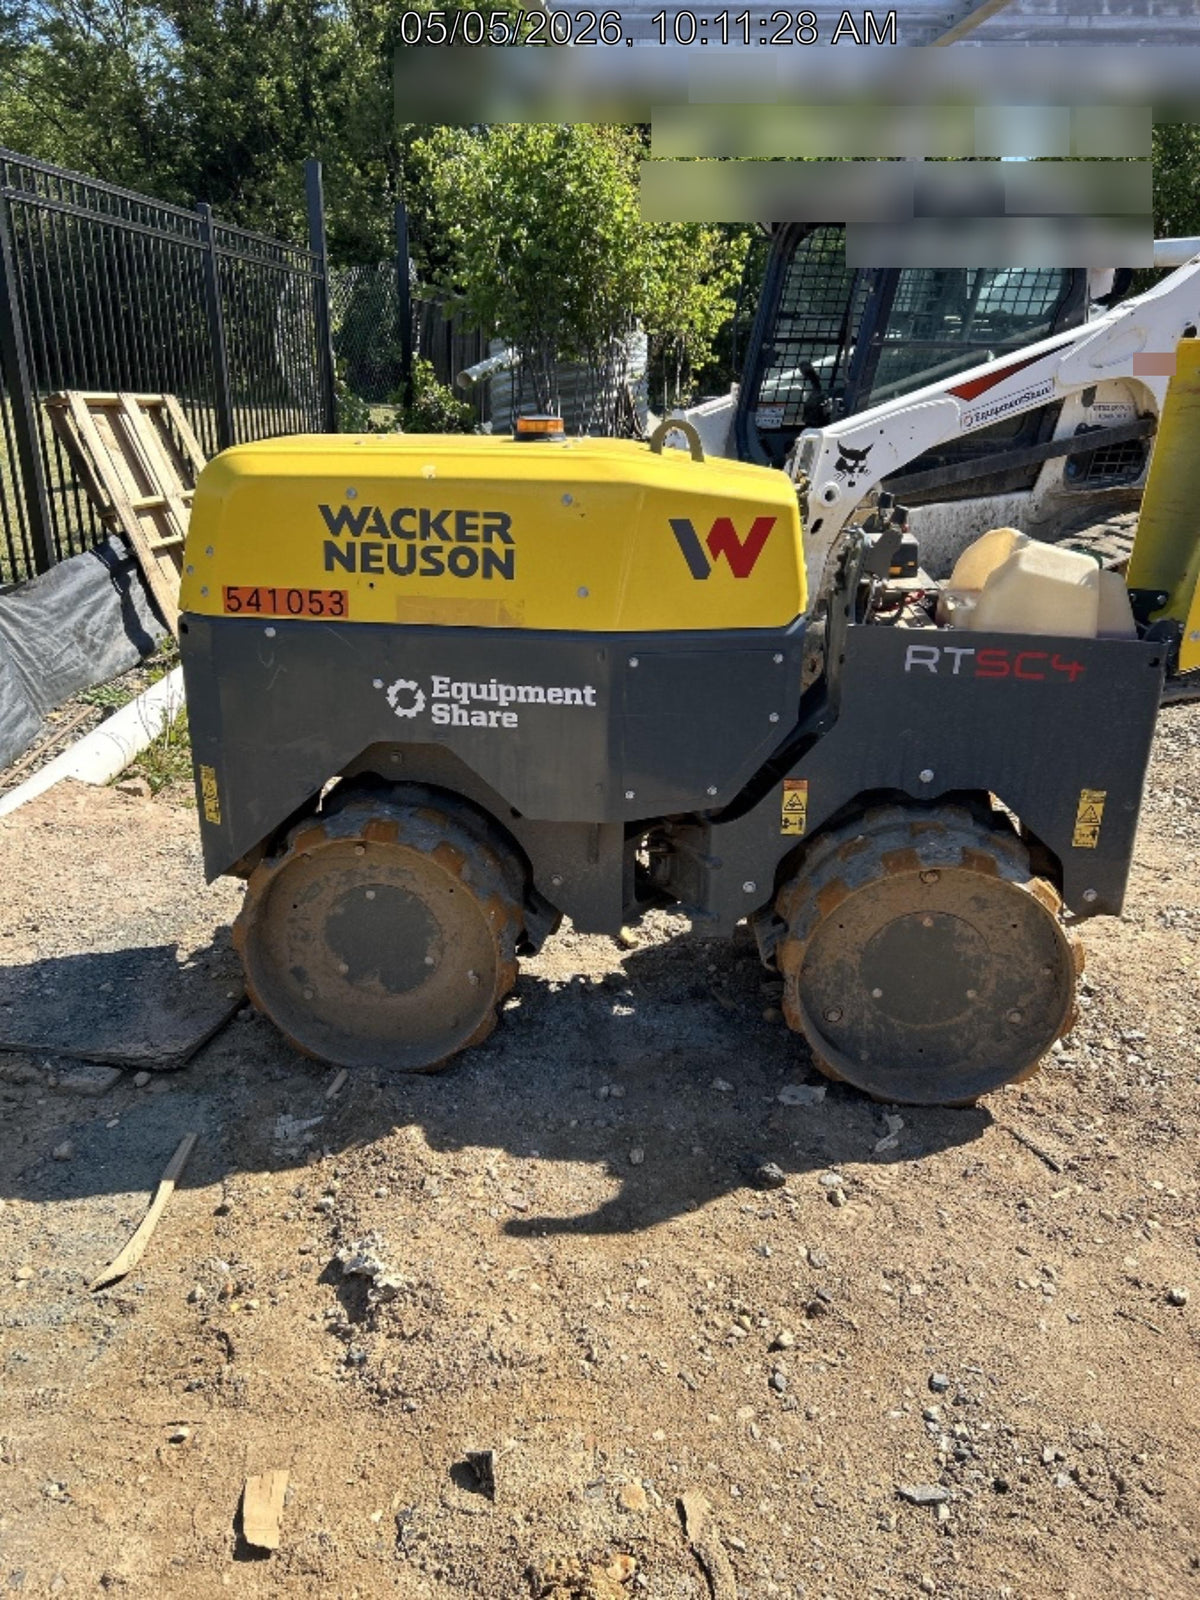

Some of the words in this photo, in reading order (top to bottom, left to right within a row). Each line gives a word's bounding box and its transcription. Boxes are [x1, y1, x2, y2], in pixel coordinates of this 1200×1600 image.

[318, 504, 516, 545] WACKER
[323, 540, 515, 580] NEUSON
[226, 587, 345, 616] 541053
[431, 675, 597, 706] Equipment
[431, 703, 519, 728] Share
